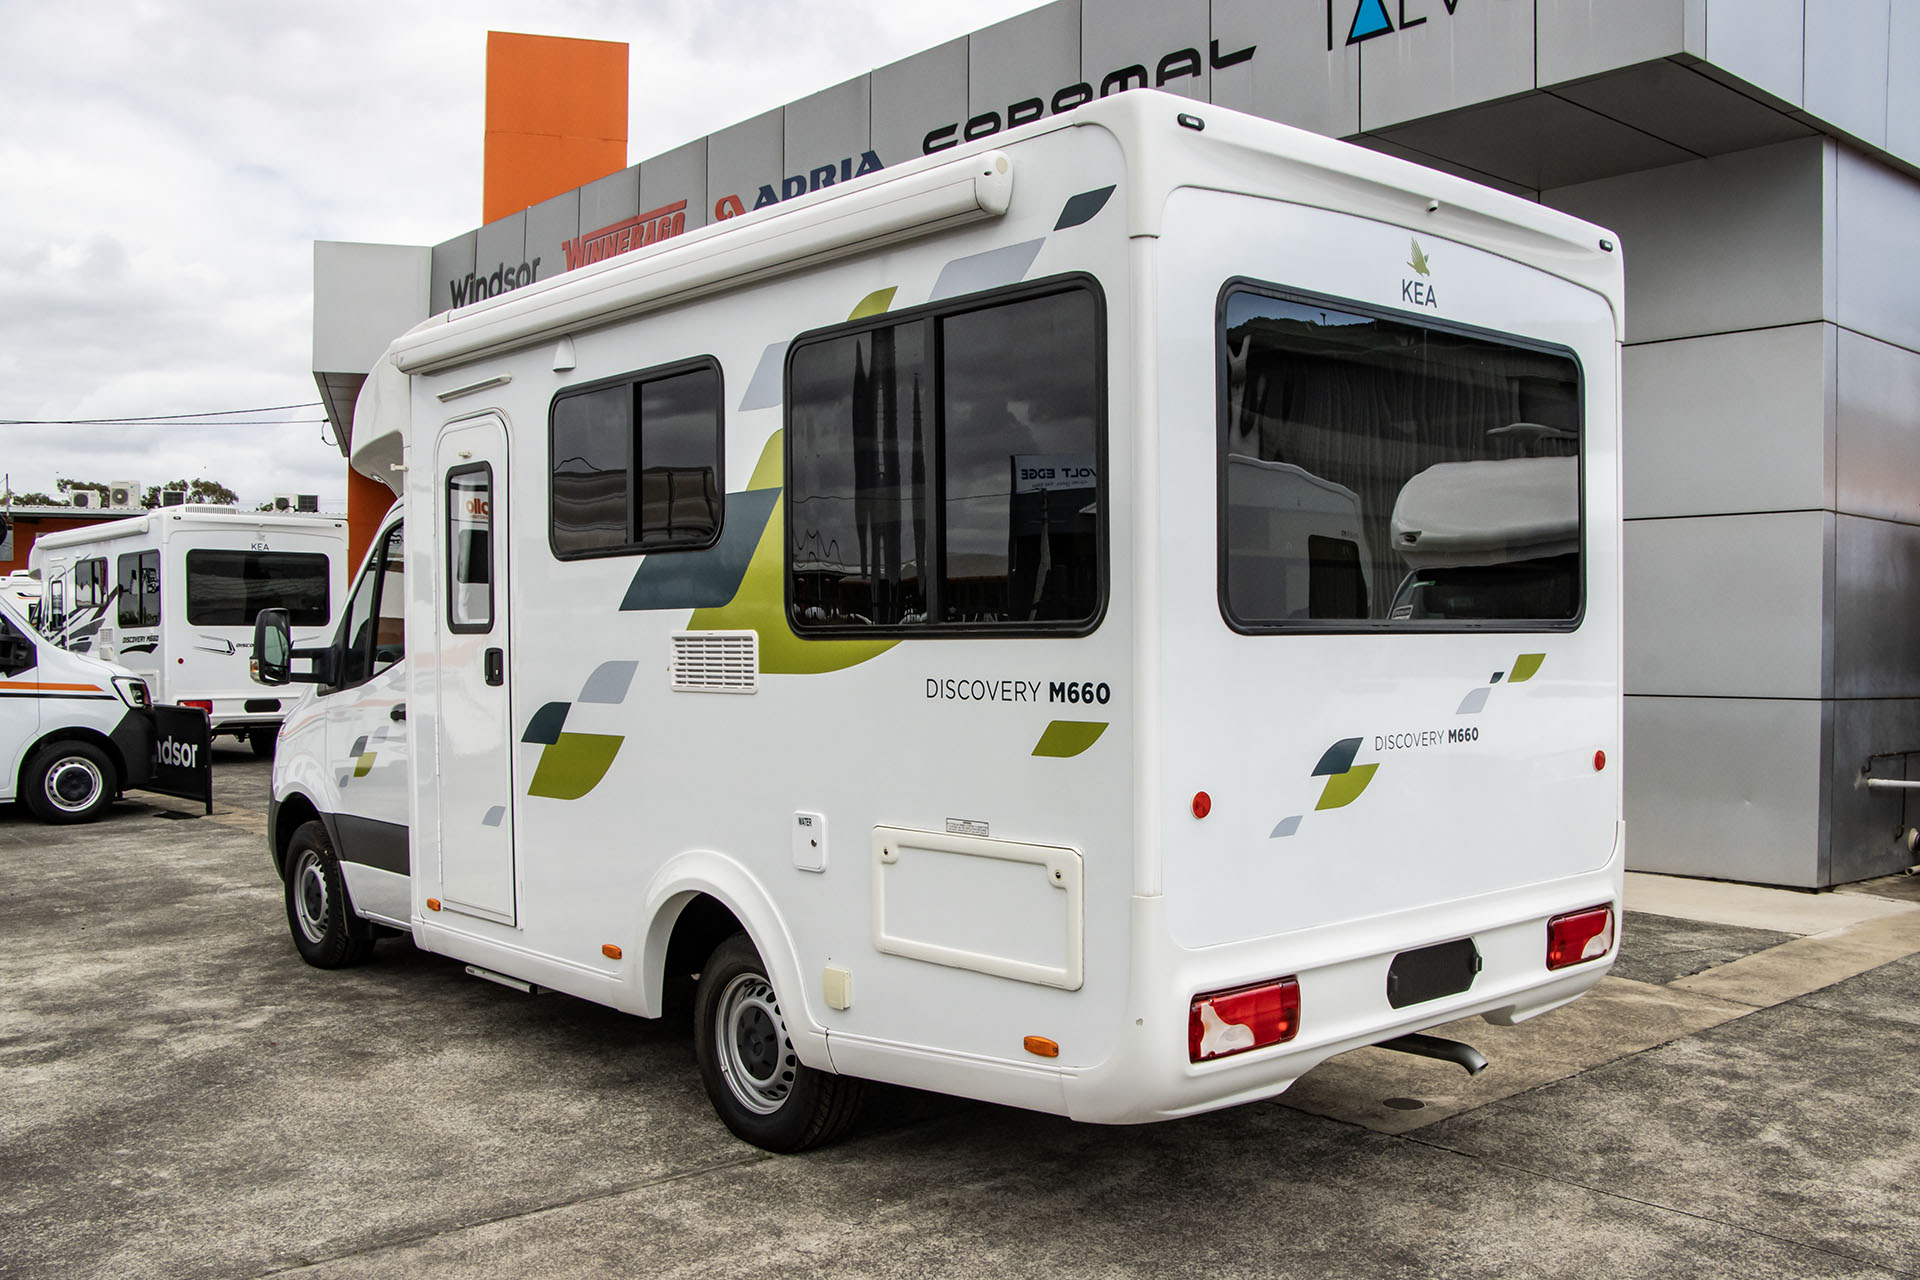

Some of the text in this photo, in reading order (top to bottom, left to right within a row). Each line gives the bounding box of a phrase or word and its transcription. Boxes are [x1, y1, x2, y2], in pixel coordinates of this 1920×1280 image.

[922, 39, 1257, 156] COROMAL
[753, 150, 885, 211] ADRIA
[450, 256, 541, 309] Windsor
[1402, 278, 1438, 308] KEA
[251, 543, 270, 551] KEA
[926, 678, 1111, 705] DISCOVERY M660
[1375, 727, 1479, 751] DISCOVERY M660
